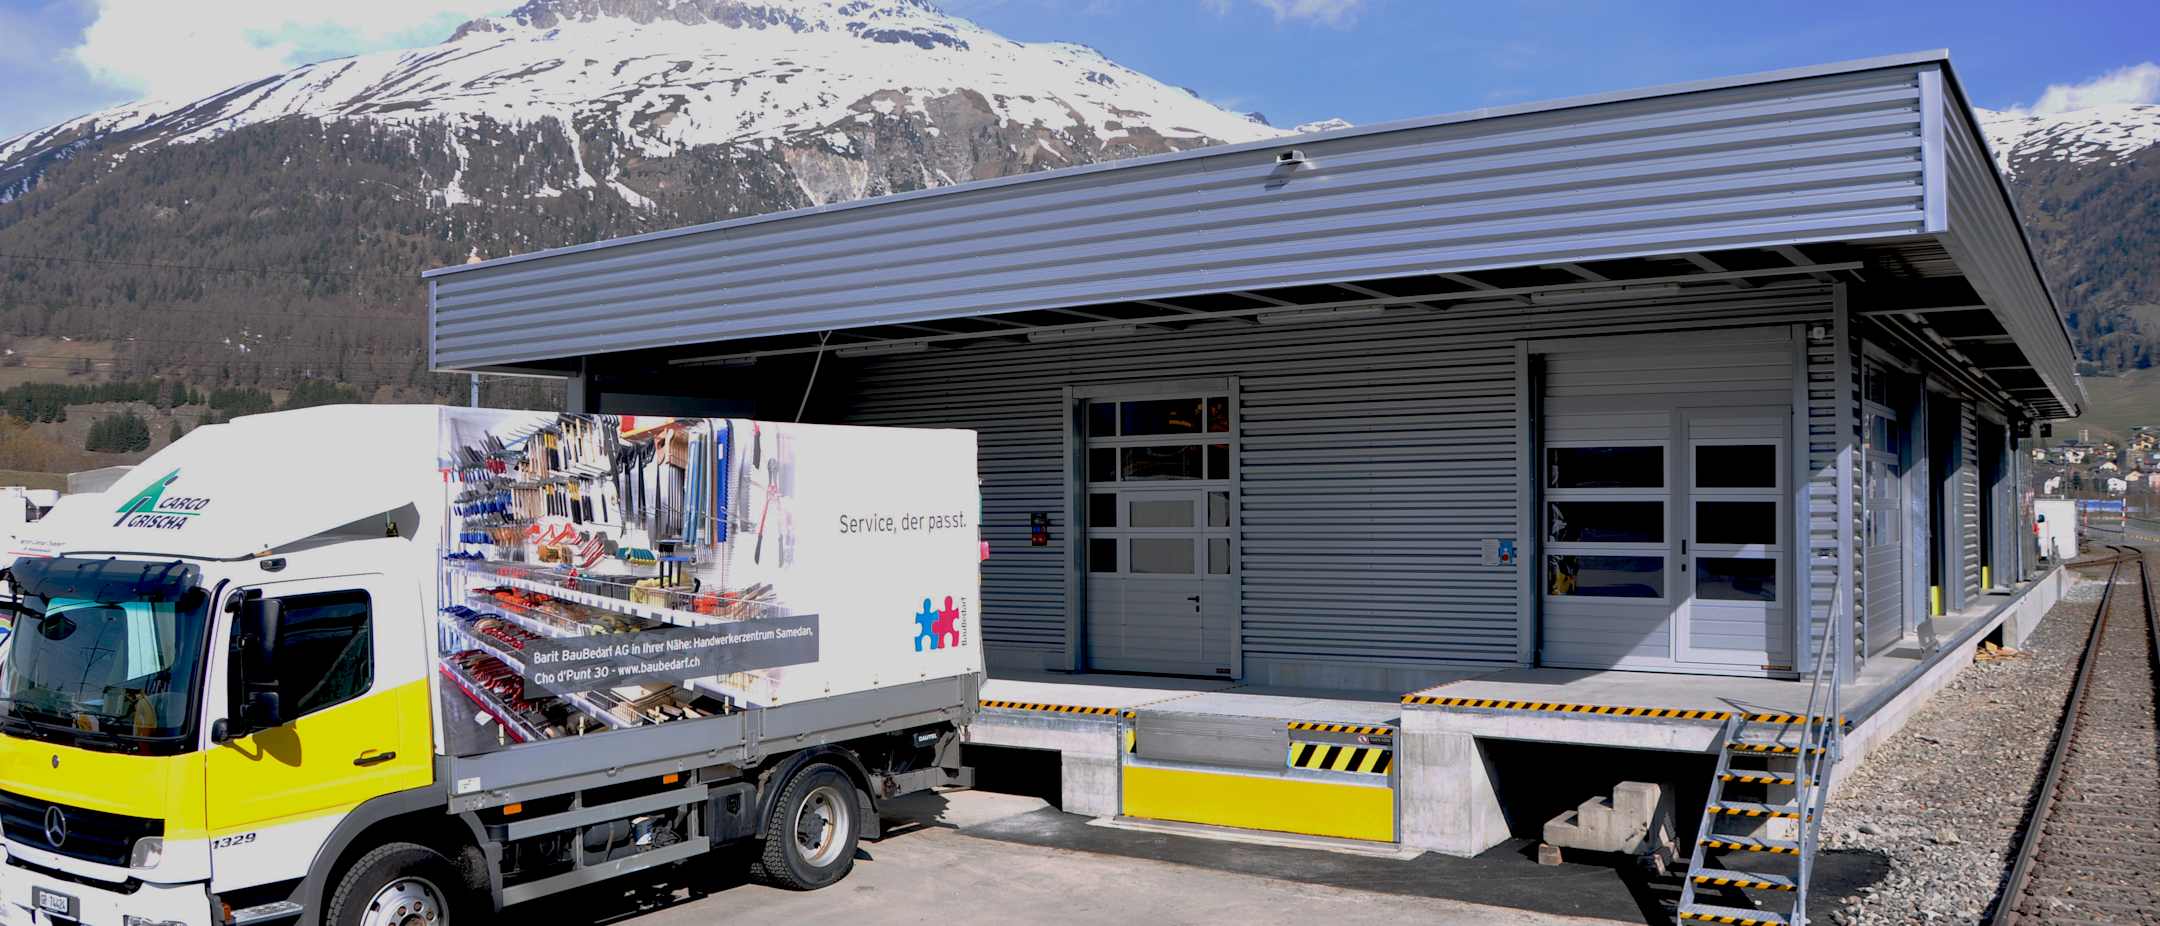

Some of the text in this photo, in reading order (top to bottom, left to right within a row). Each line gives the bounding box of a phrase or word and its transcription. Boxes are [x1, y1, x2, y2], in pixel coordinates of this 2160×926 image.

[159, 497, 210, 511] CARGO
[128, 515, 188, 530] GRISCHA
[839, 511, 967, 534] Service, der passt.
[533, 626, 814, 664] Barit BauBedarf AG in Ihrer Nähe: Handwerkerzentrum Samedan,
[534, 672, 555, 685] Cho
[594, 666, 609, 679] 30
[617, 656, 700, 676] www.baubedarf.ch
[212, 832, 257, 850] 1329
